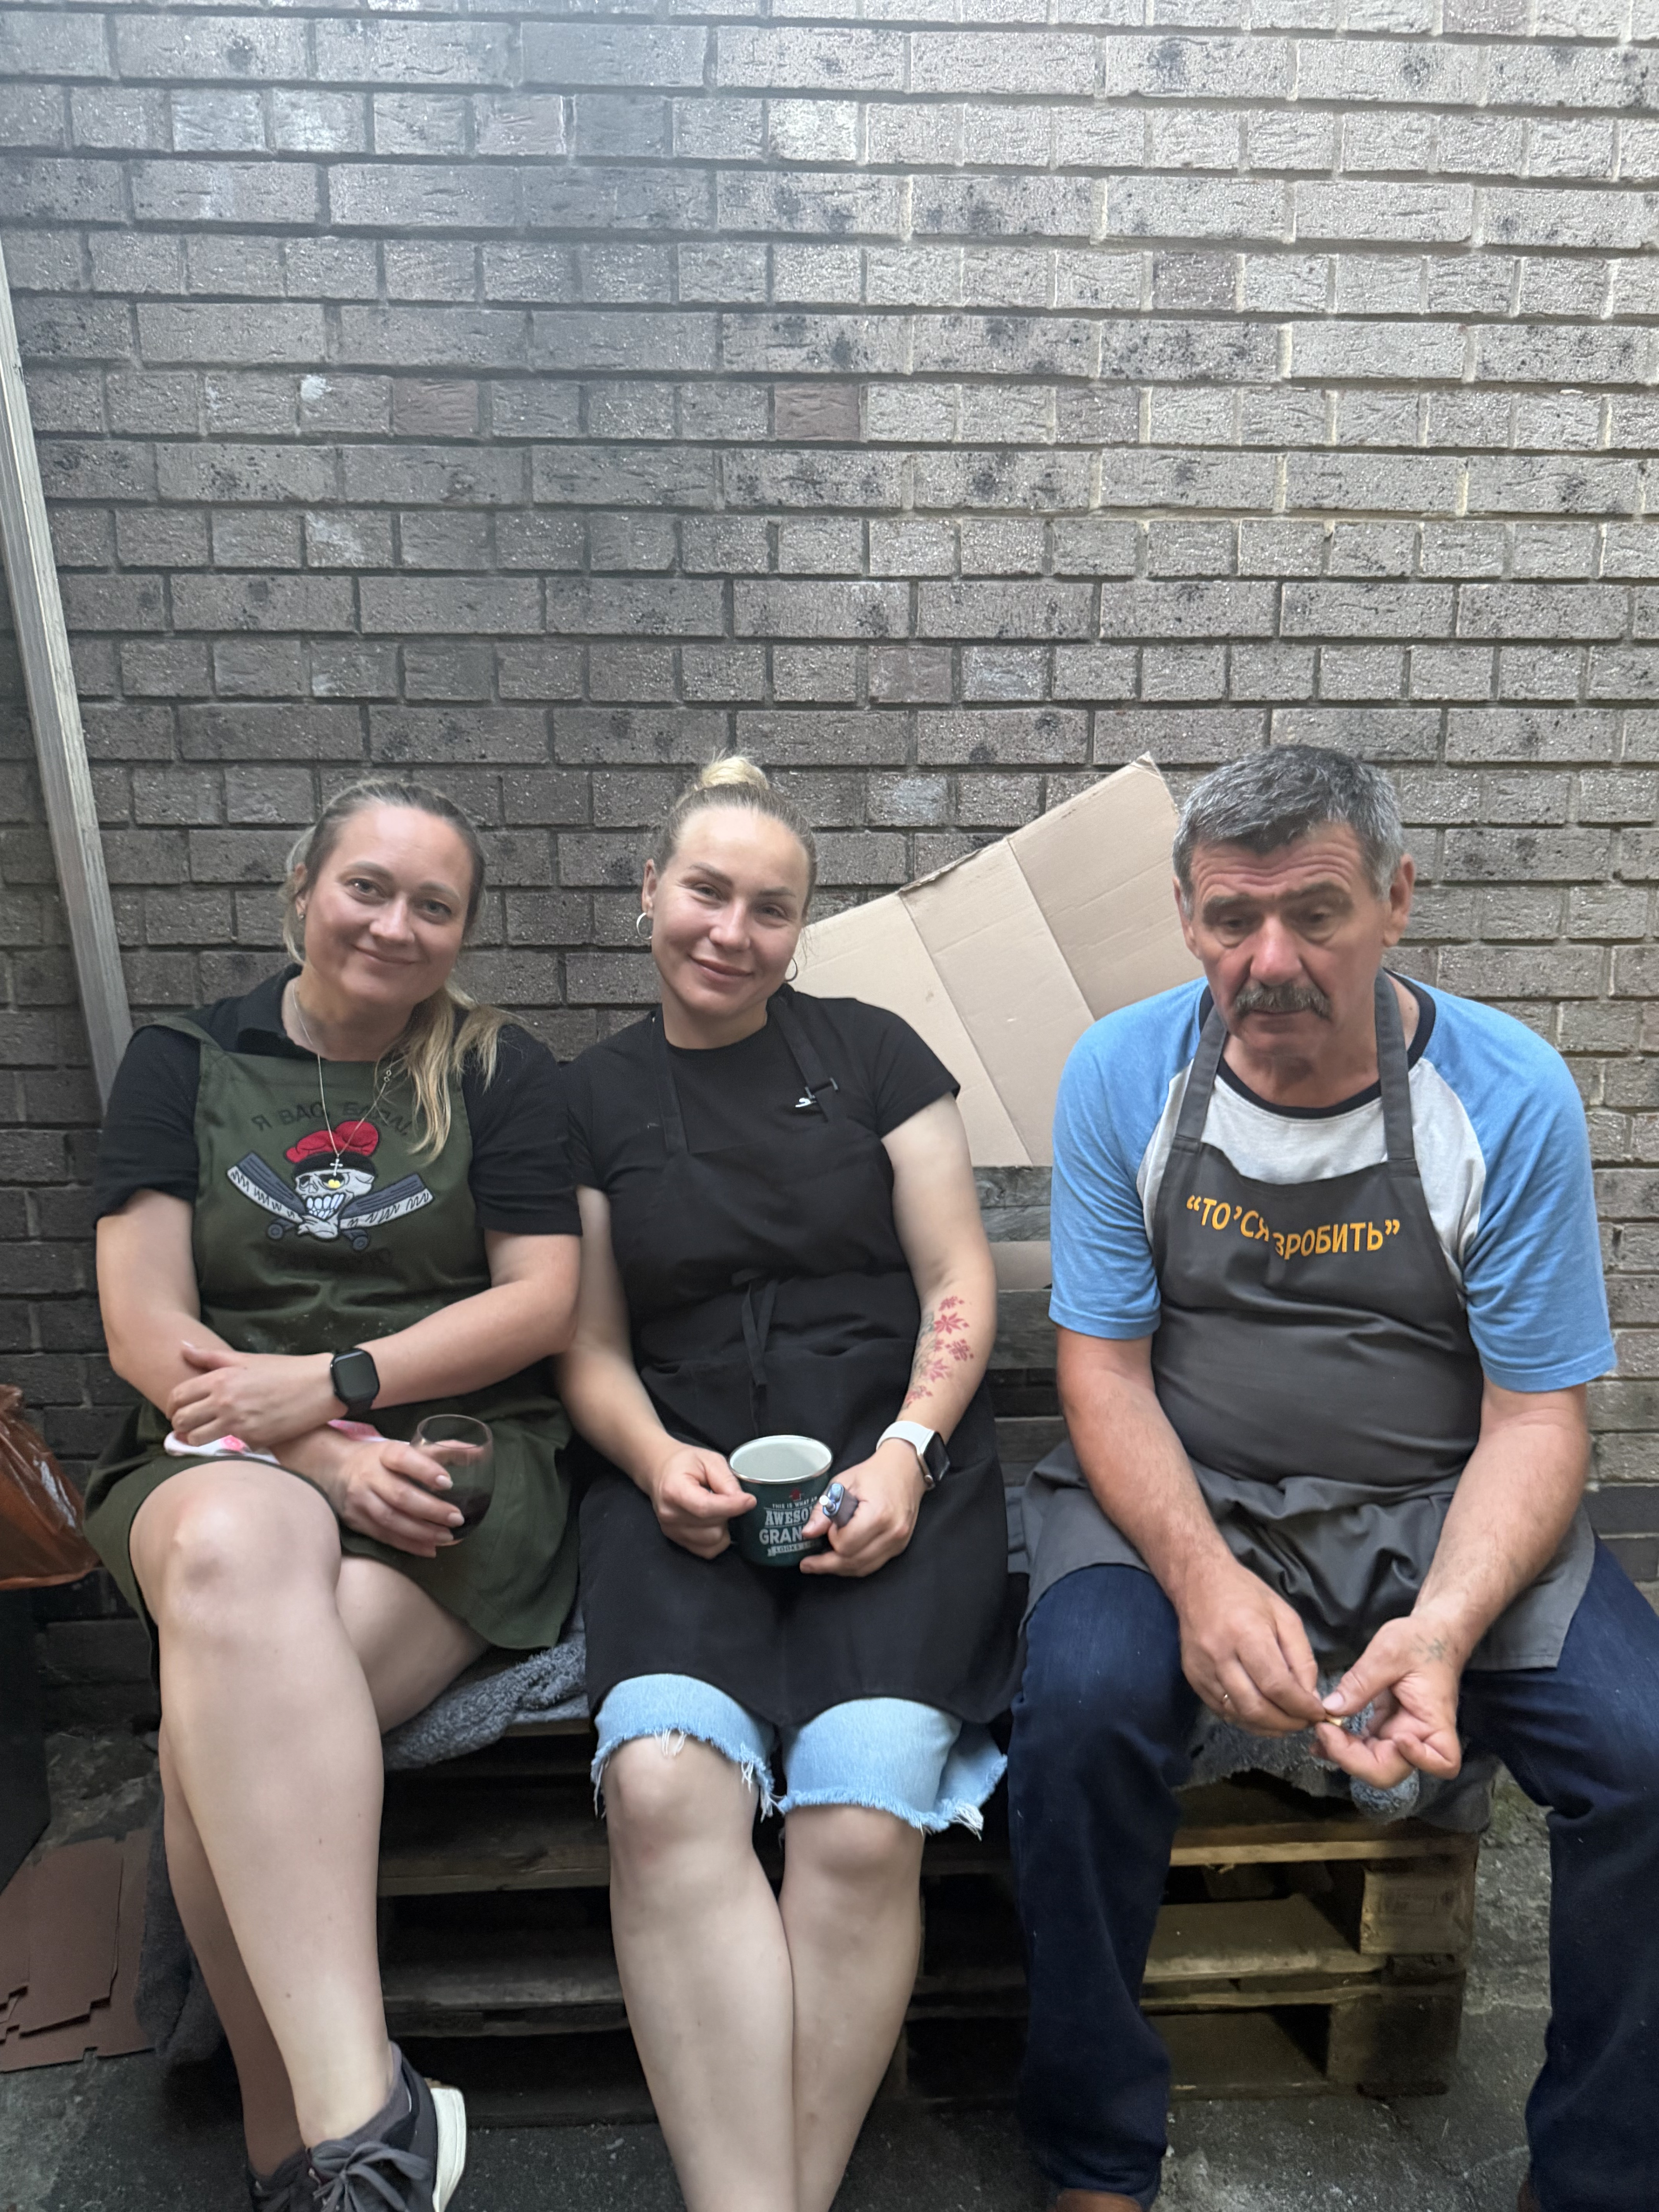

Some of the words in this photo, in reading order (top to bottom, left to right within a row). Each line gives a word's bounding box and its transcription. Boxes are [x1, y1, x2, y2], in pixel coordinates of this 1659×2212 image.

[794, 1499, 809, 1507] WHAT
[765, 1506, 812, 1526] AWESO
[759, 1526, 803, 1545] GRAN
